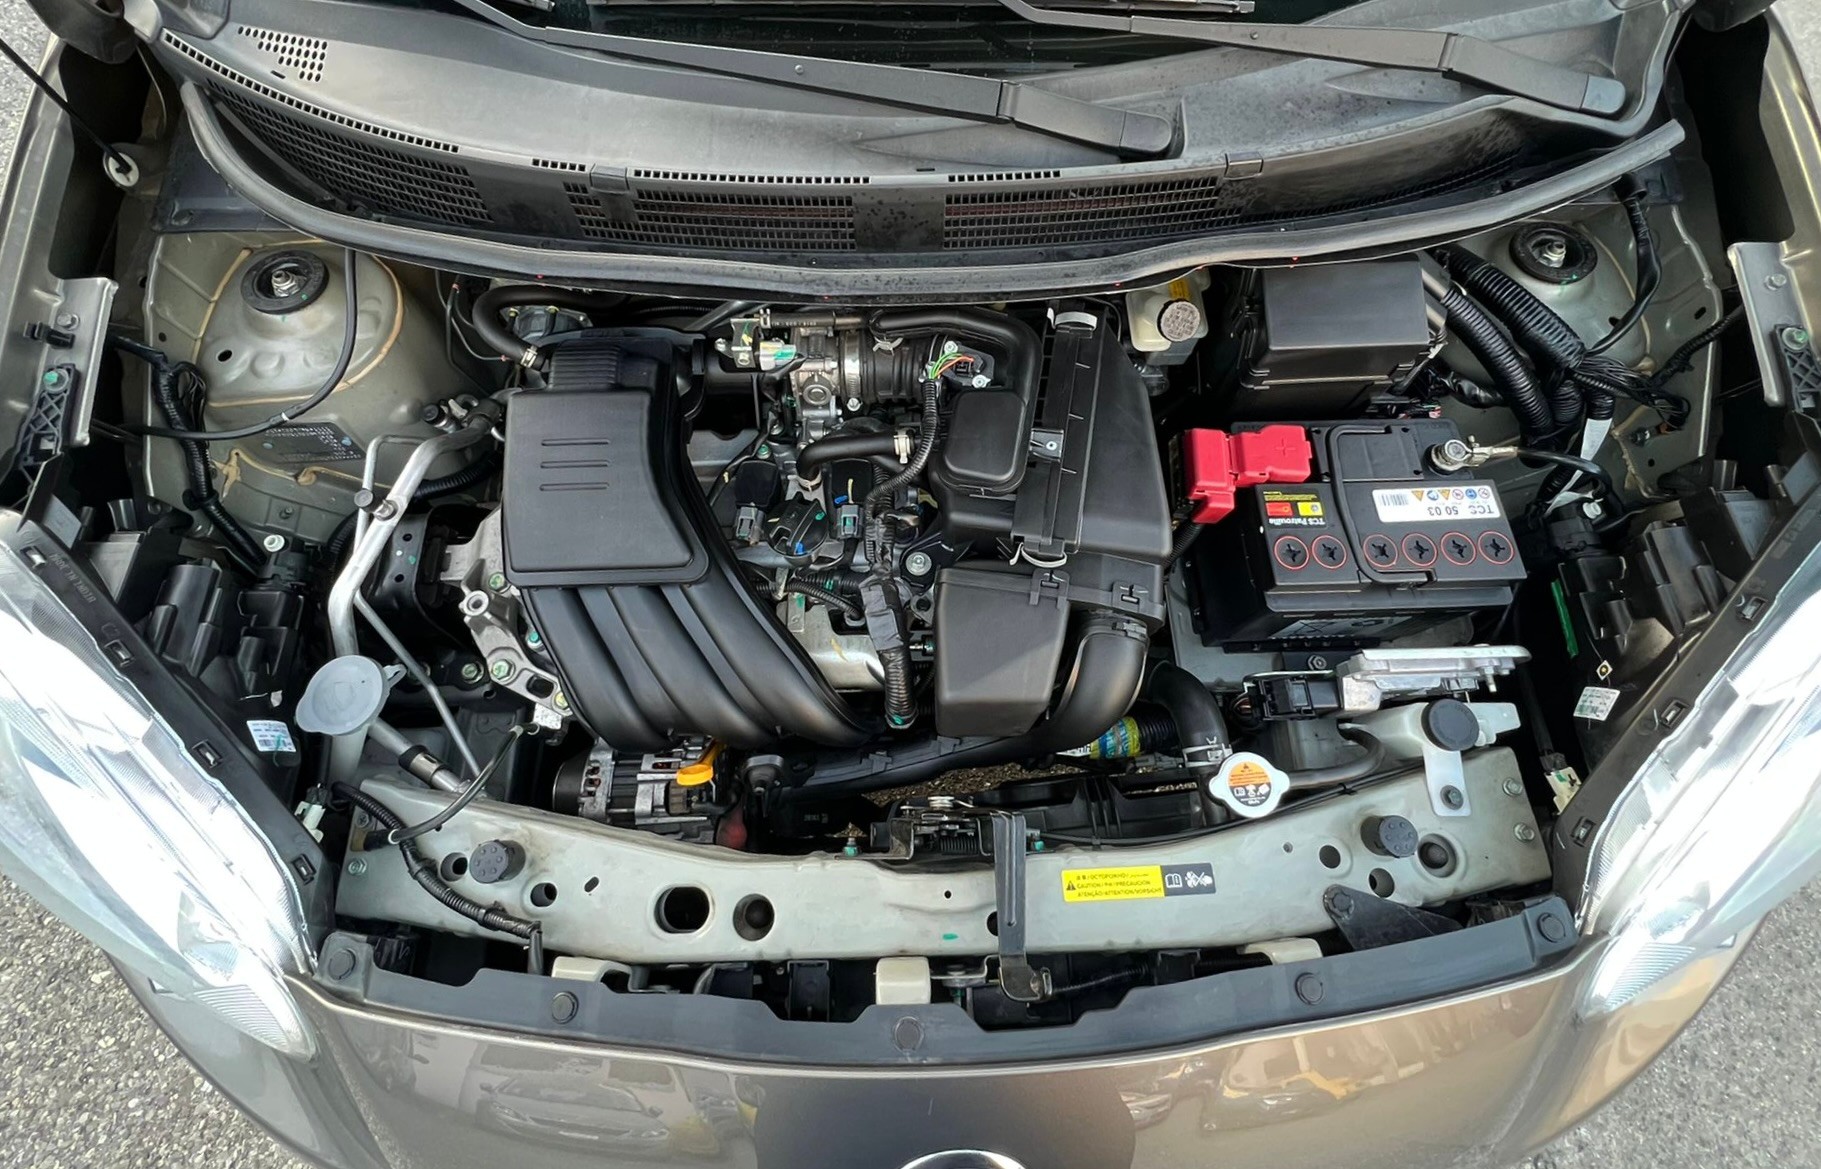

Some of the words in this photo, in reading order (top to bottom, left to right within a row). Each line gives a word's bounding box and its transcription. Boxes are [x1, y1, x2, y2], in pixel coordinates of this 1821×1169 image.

[1427, 506, 1442, 517] 03
[1445, 505, 1459, 516] 50
[1467, 504, 1494, 515] TCS
[1307, 518, 1326, 526] TCS
